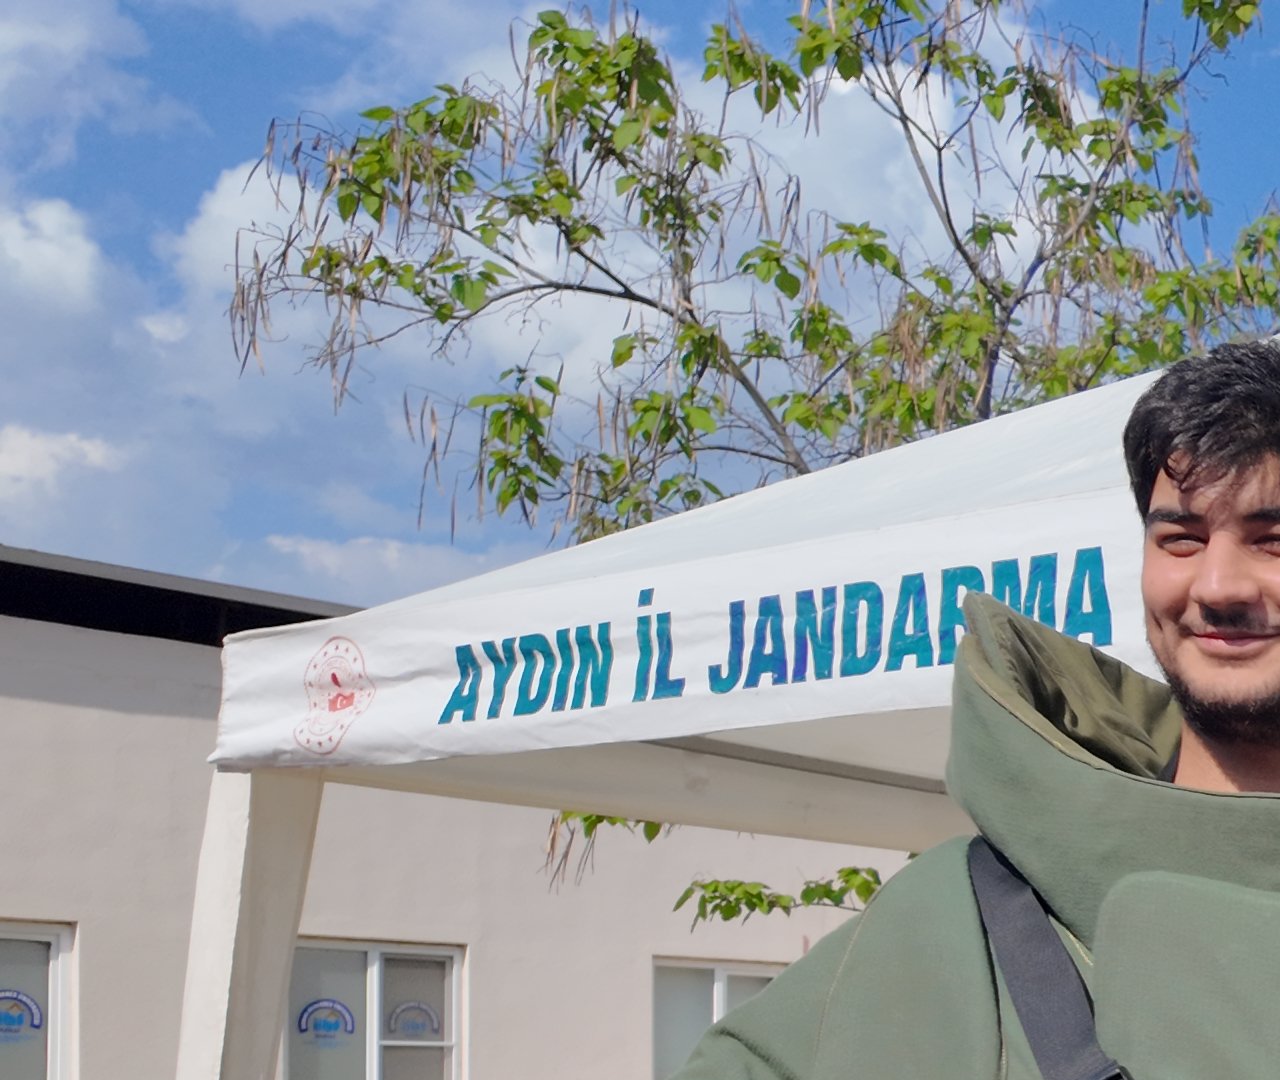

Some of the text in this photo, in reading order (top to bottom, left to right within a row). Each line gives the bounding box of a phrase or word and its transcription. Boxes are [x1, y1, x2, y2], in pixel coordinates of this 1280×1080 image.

[437, 621, 613, 725] AYDIN
[632, 587, 686, 703] İL
[708, 546, 1113, 695] JANDARMA
